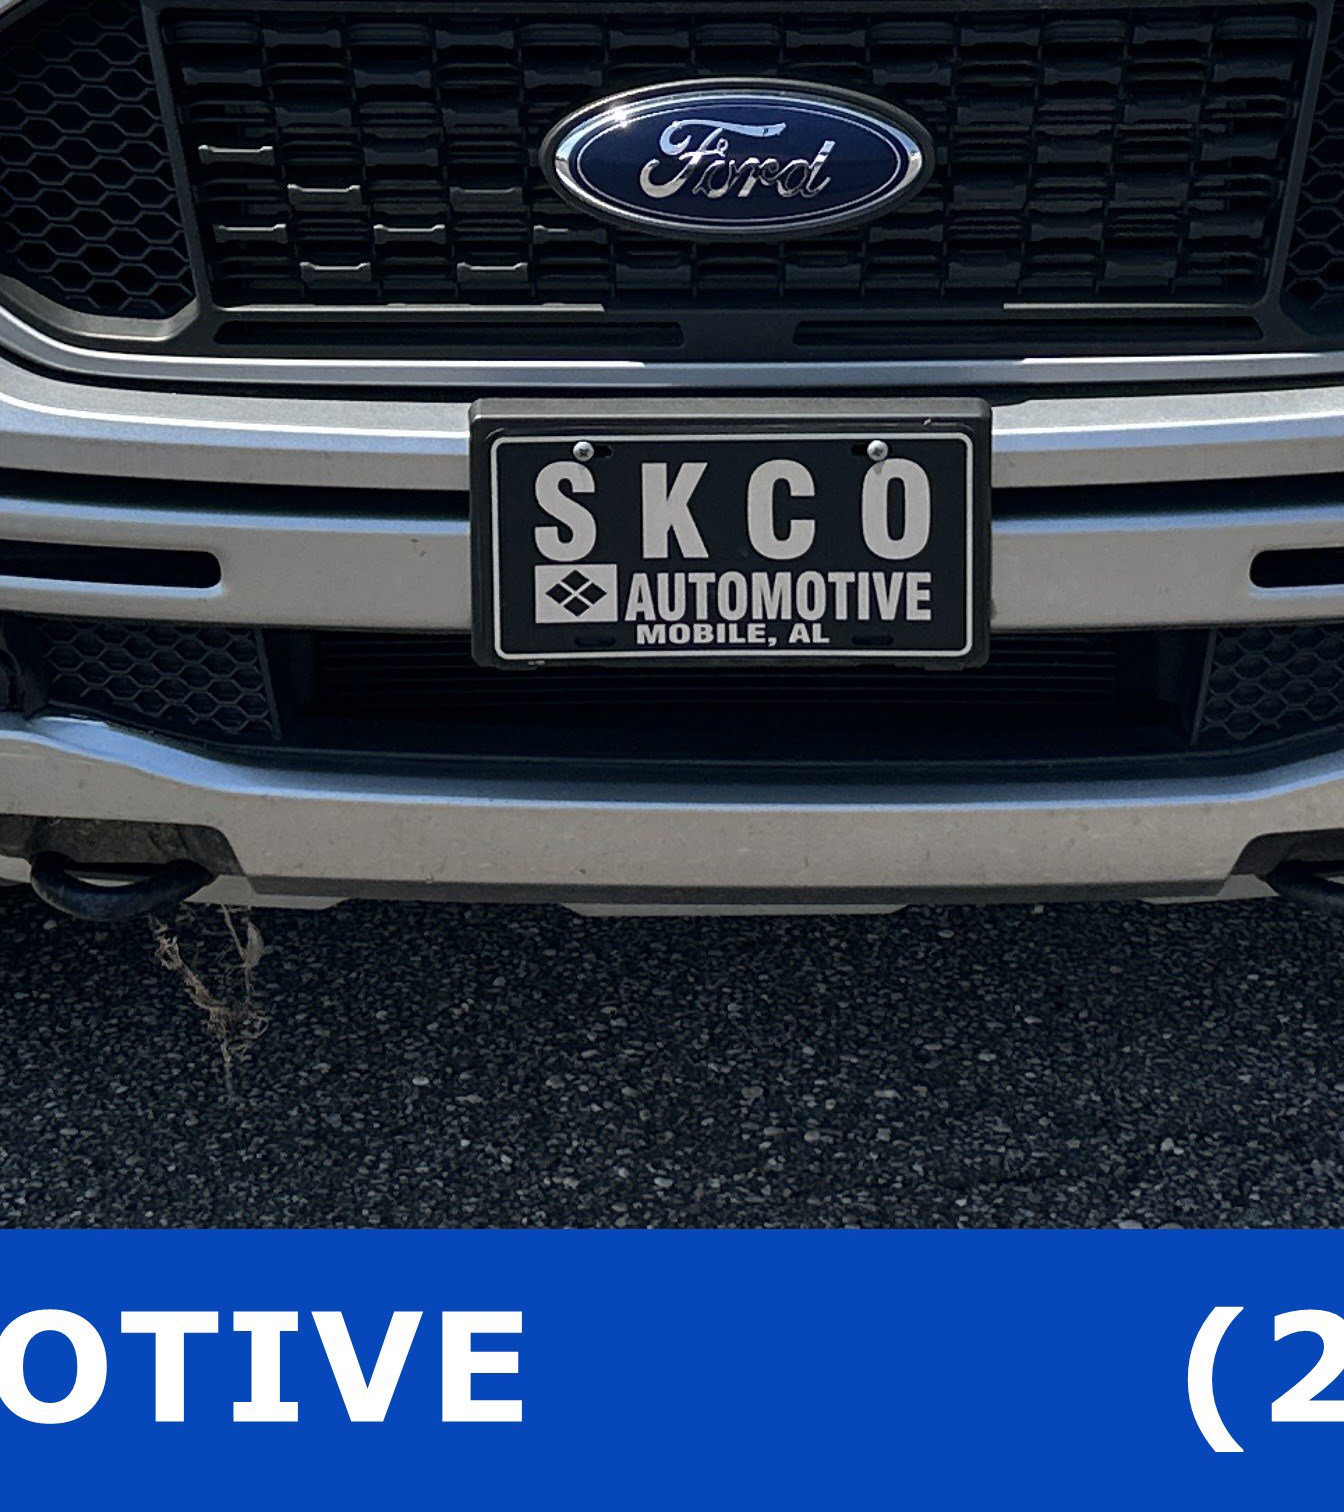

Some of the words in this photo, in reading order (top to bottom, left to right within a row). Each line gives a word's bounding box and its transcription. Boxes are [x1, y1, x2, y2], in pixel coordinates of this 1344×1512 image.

[639, 119, 836, 199] Ford
[534, 458, 931, 562] SKCO
[625, 570, 932, 622] AUTOMOTIVE
[636, 623, 778, 647] MOBILE,
[788, 622, 830, 645] AL
